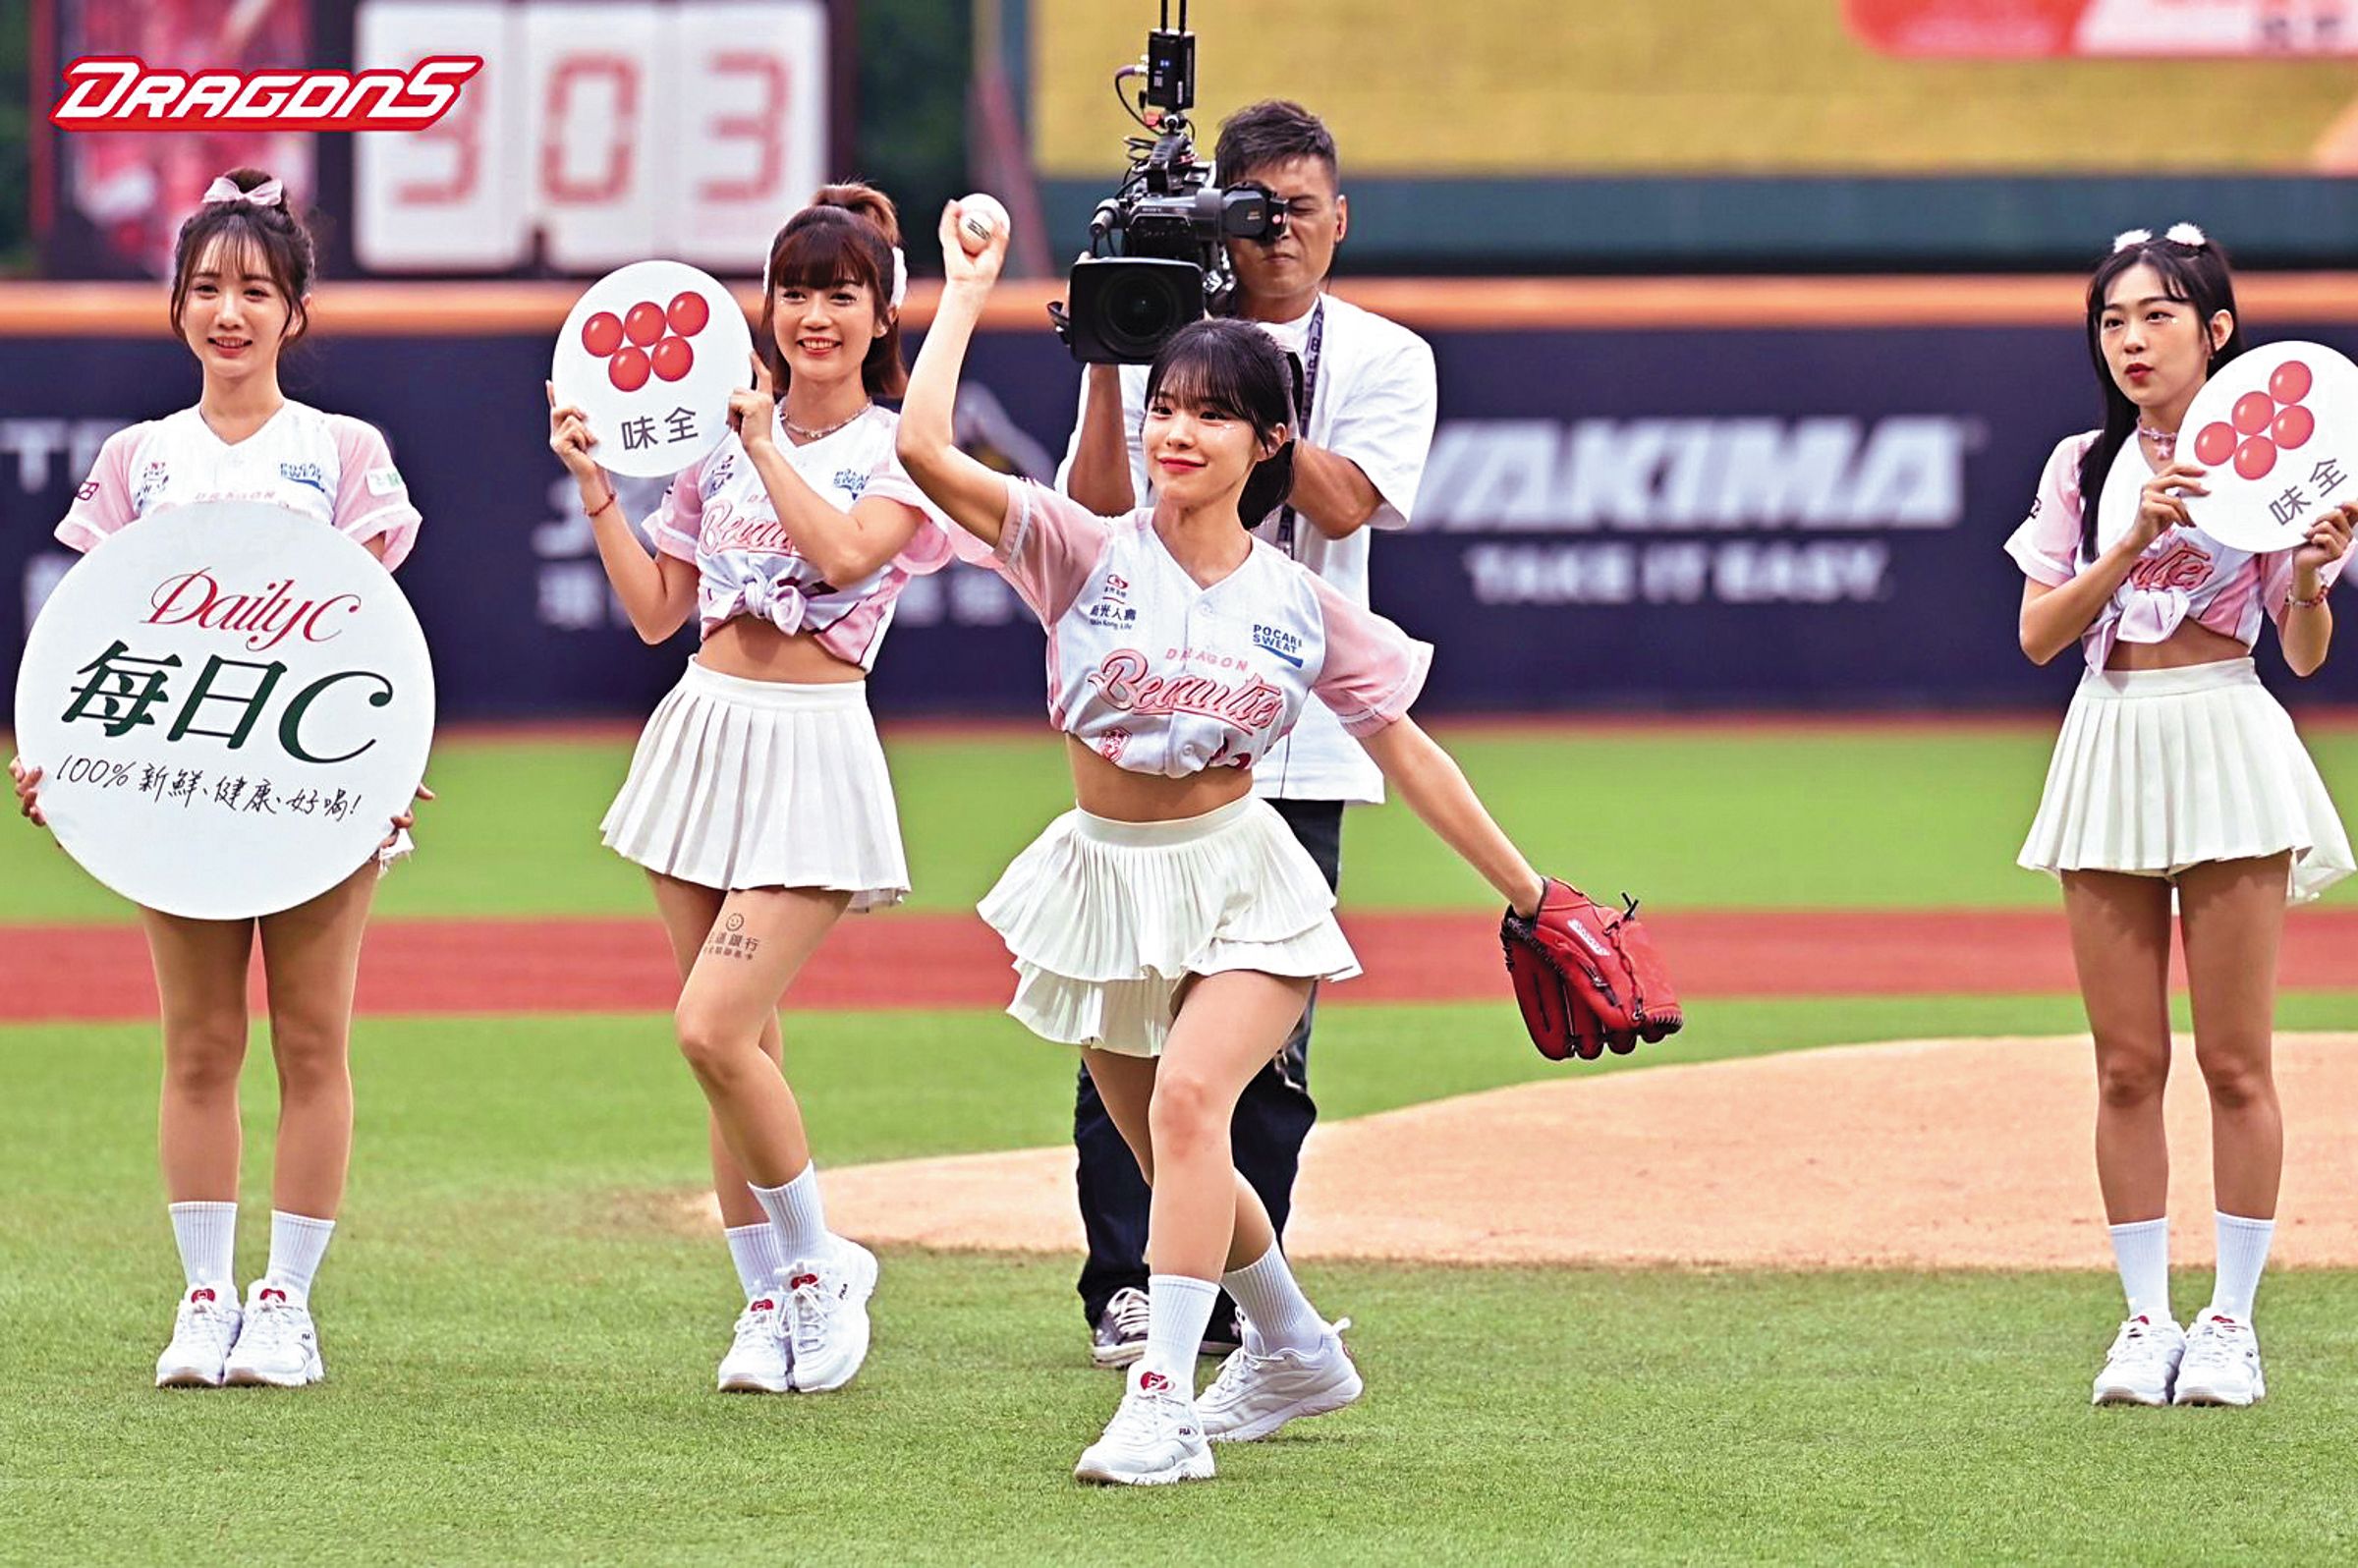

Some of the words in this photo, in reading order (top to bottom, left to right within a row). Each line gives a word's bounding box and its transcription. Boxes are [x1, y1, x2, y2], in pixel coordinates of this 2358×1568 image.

[621, 406, 699, 451] 味全
[2268, 458, 2348, 527] 味全
[1253, 624, 1303, 648] POCARI
[1253, 634, 1297, 654] SWEAT
[1164, 647, 1249, 672] DRAGON
[62, 639, 394, 763] 每日C
